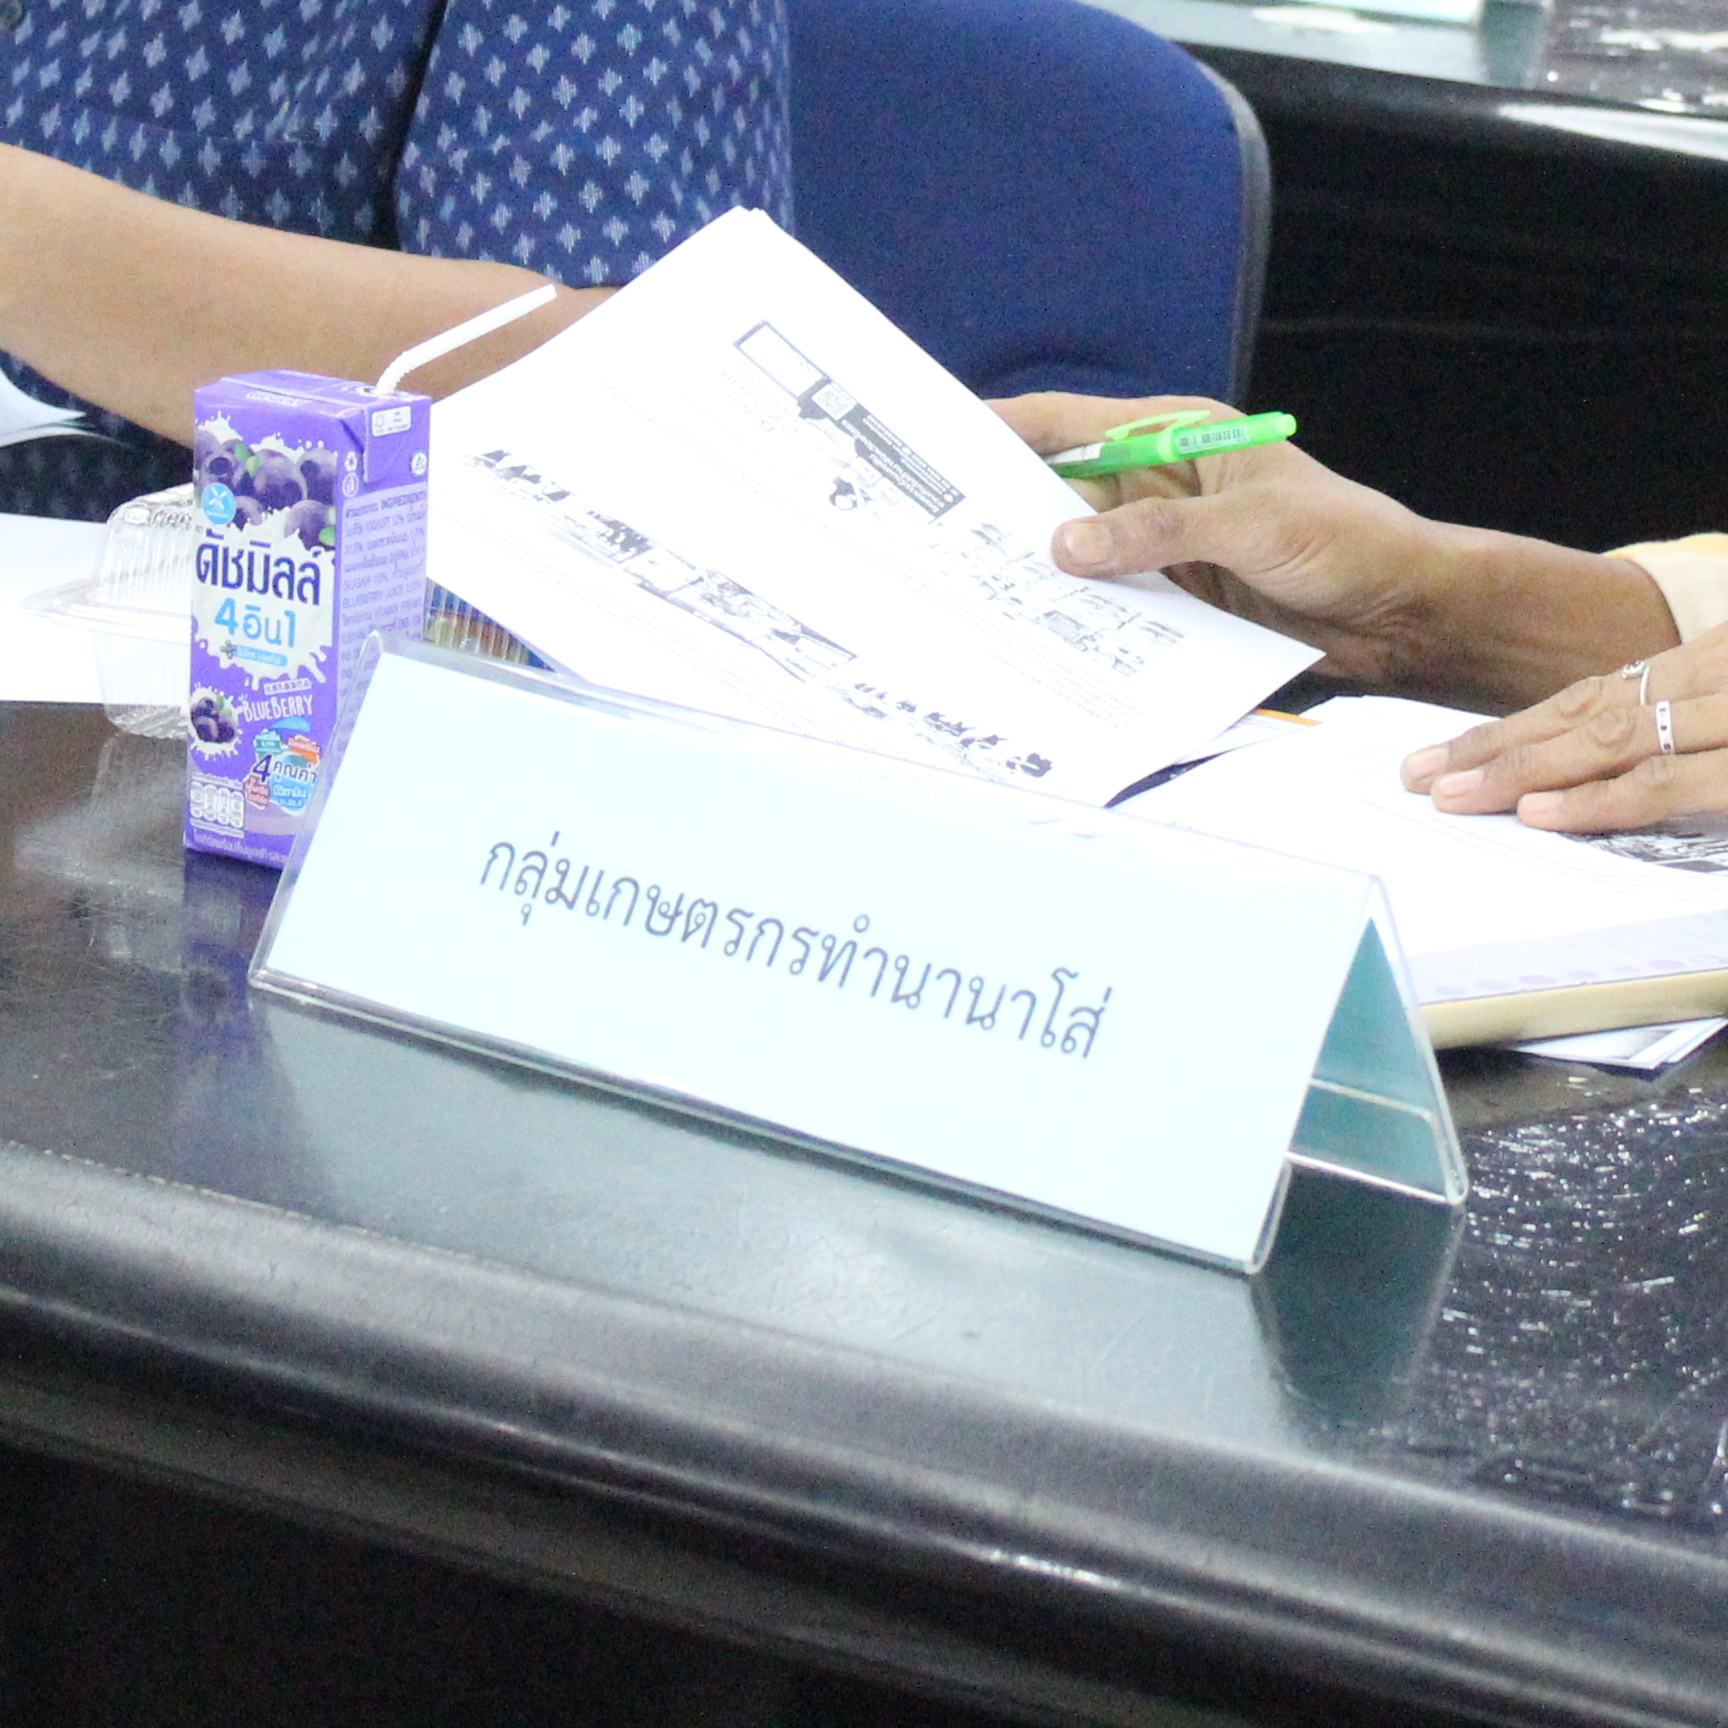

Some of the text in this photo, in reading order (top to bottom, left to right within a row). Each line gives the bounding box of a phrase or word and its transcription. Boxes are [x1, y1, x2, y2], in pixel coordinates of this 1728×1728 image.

[196, 528, 322, 607] ดัชมิลล์
[242, 694, 314, 723] BLUEBERRY
[476, 829, 1115, 1060] กลุ่มเกษตรกรทำนานาโส่
